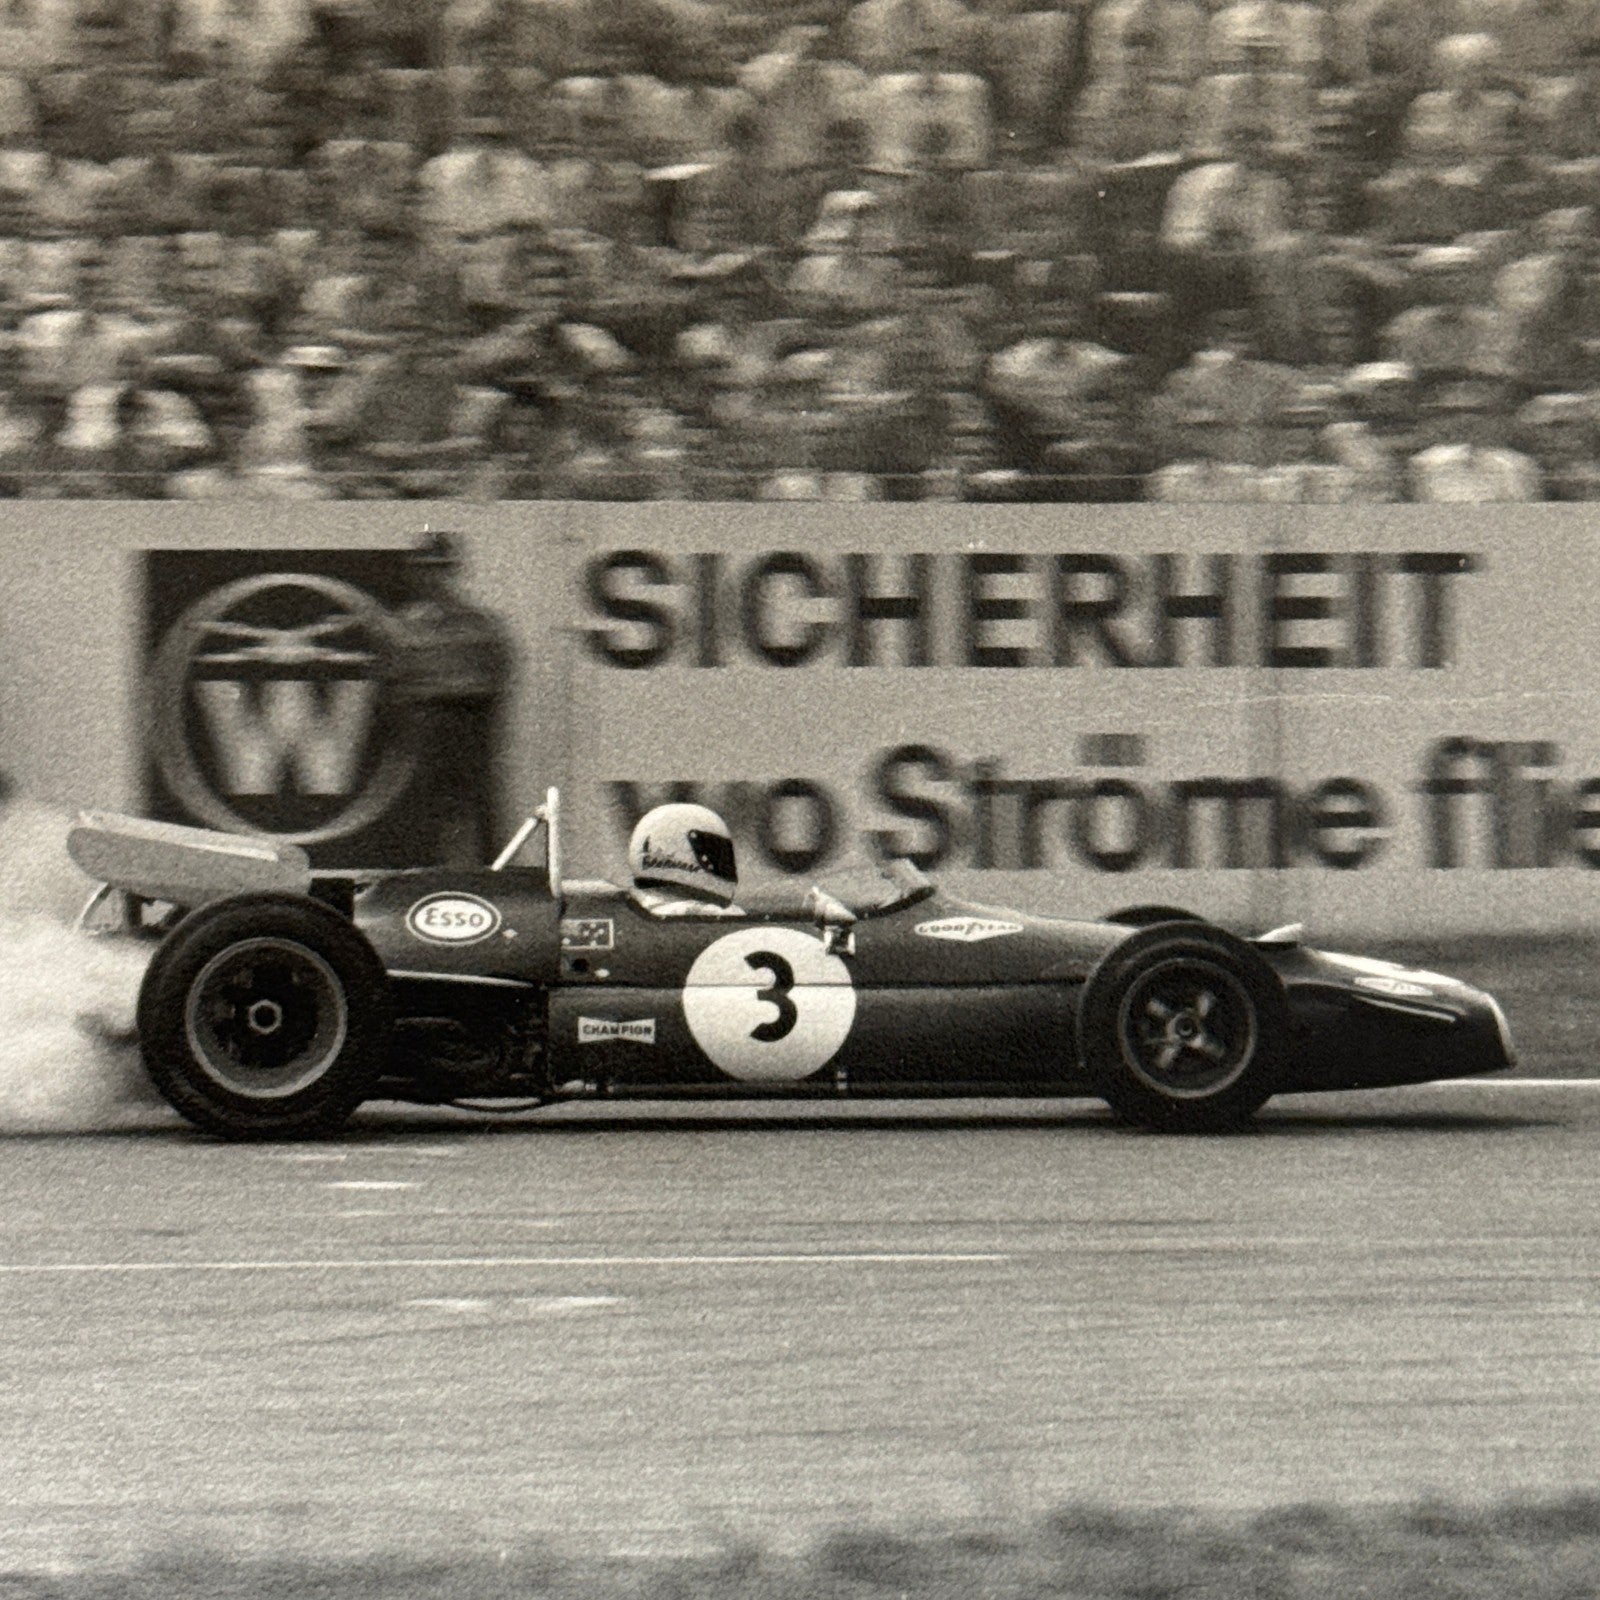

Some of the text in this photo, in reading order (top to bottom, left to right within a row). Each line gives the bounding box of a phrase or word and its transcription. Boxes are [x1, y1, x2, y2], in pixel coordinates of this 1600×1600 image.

[586, 550, 1484, 669] SICHERHEIT
[868, 733, 1392, 873] Ströme
[582, 1024, 653, 1036] CHAMPION
[743, 950, 799, 1043] 3
